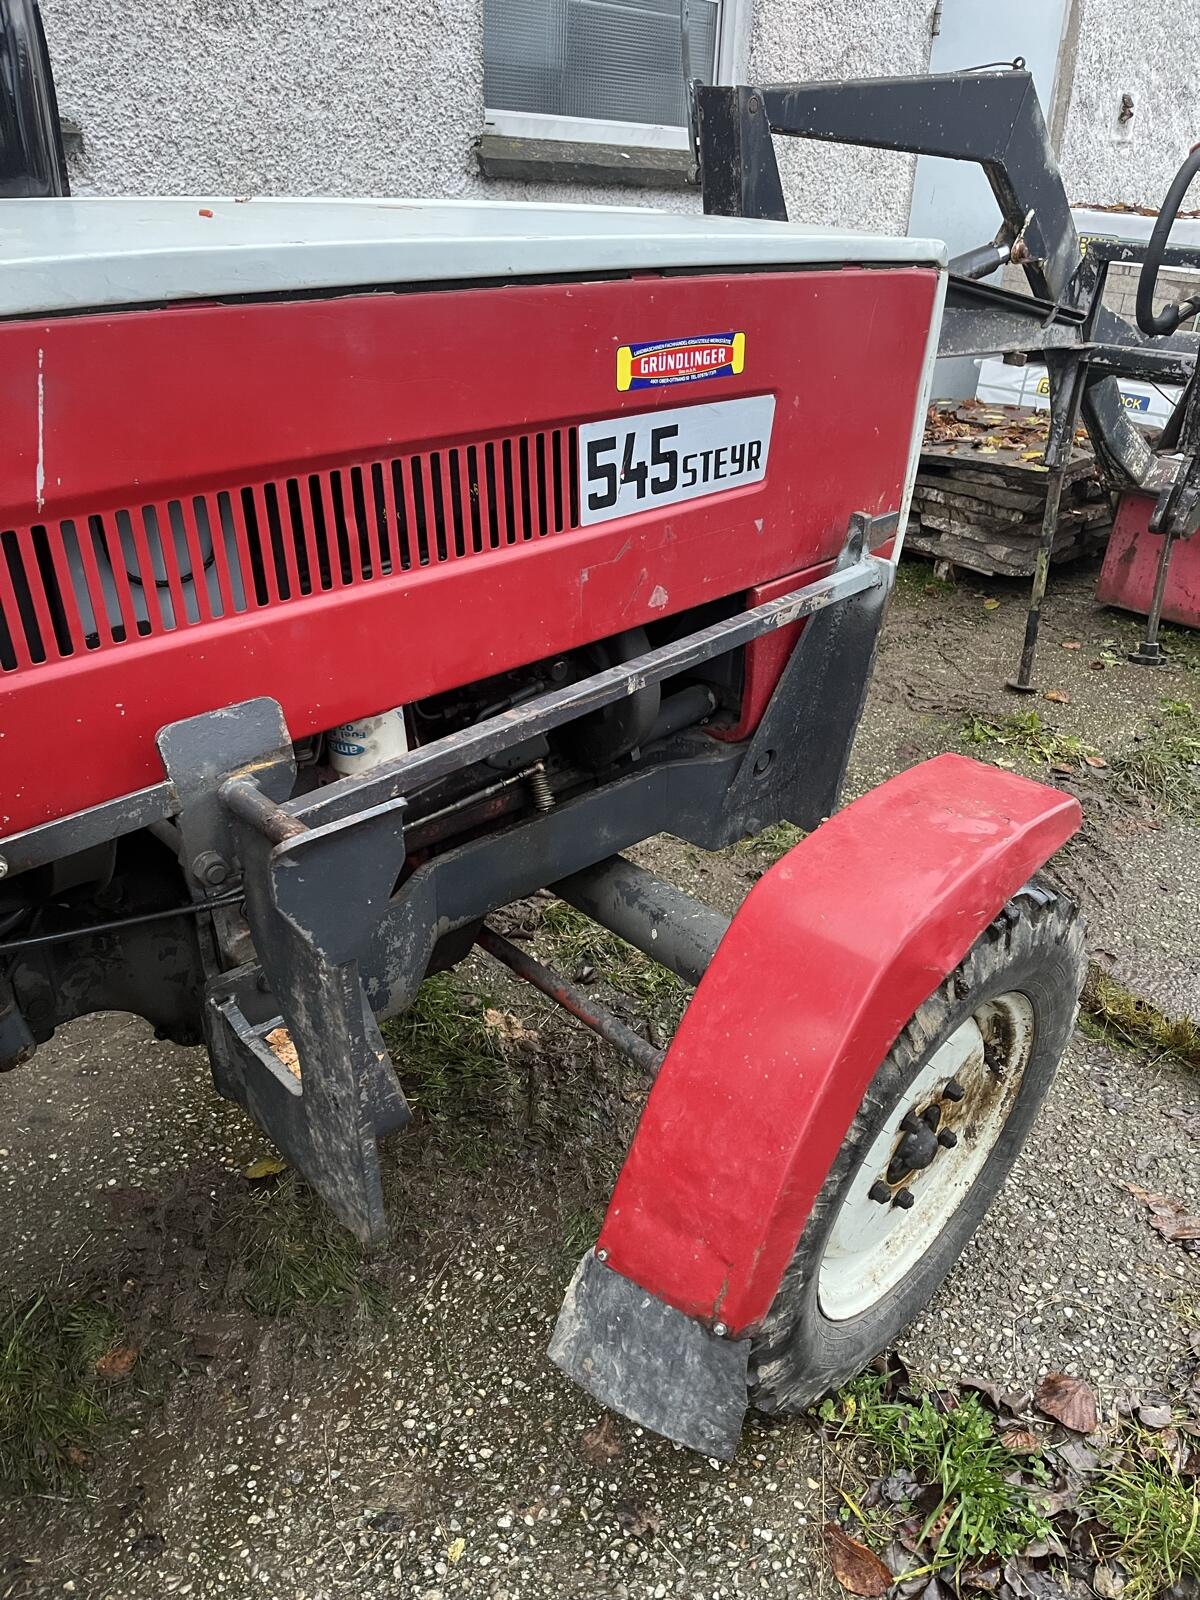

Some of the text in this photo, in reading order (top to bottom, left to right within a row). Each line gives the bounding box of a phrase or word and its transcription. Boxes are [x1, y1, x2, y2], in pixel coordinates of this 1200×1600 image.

[640, 347, 726, 374] GRÜNDLINGER
[587, 424, 762, 511] 545 STEYR
[340, 731, 366, 739] Fuel
